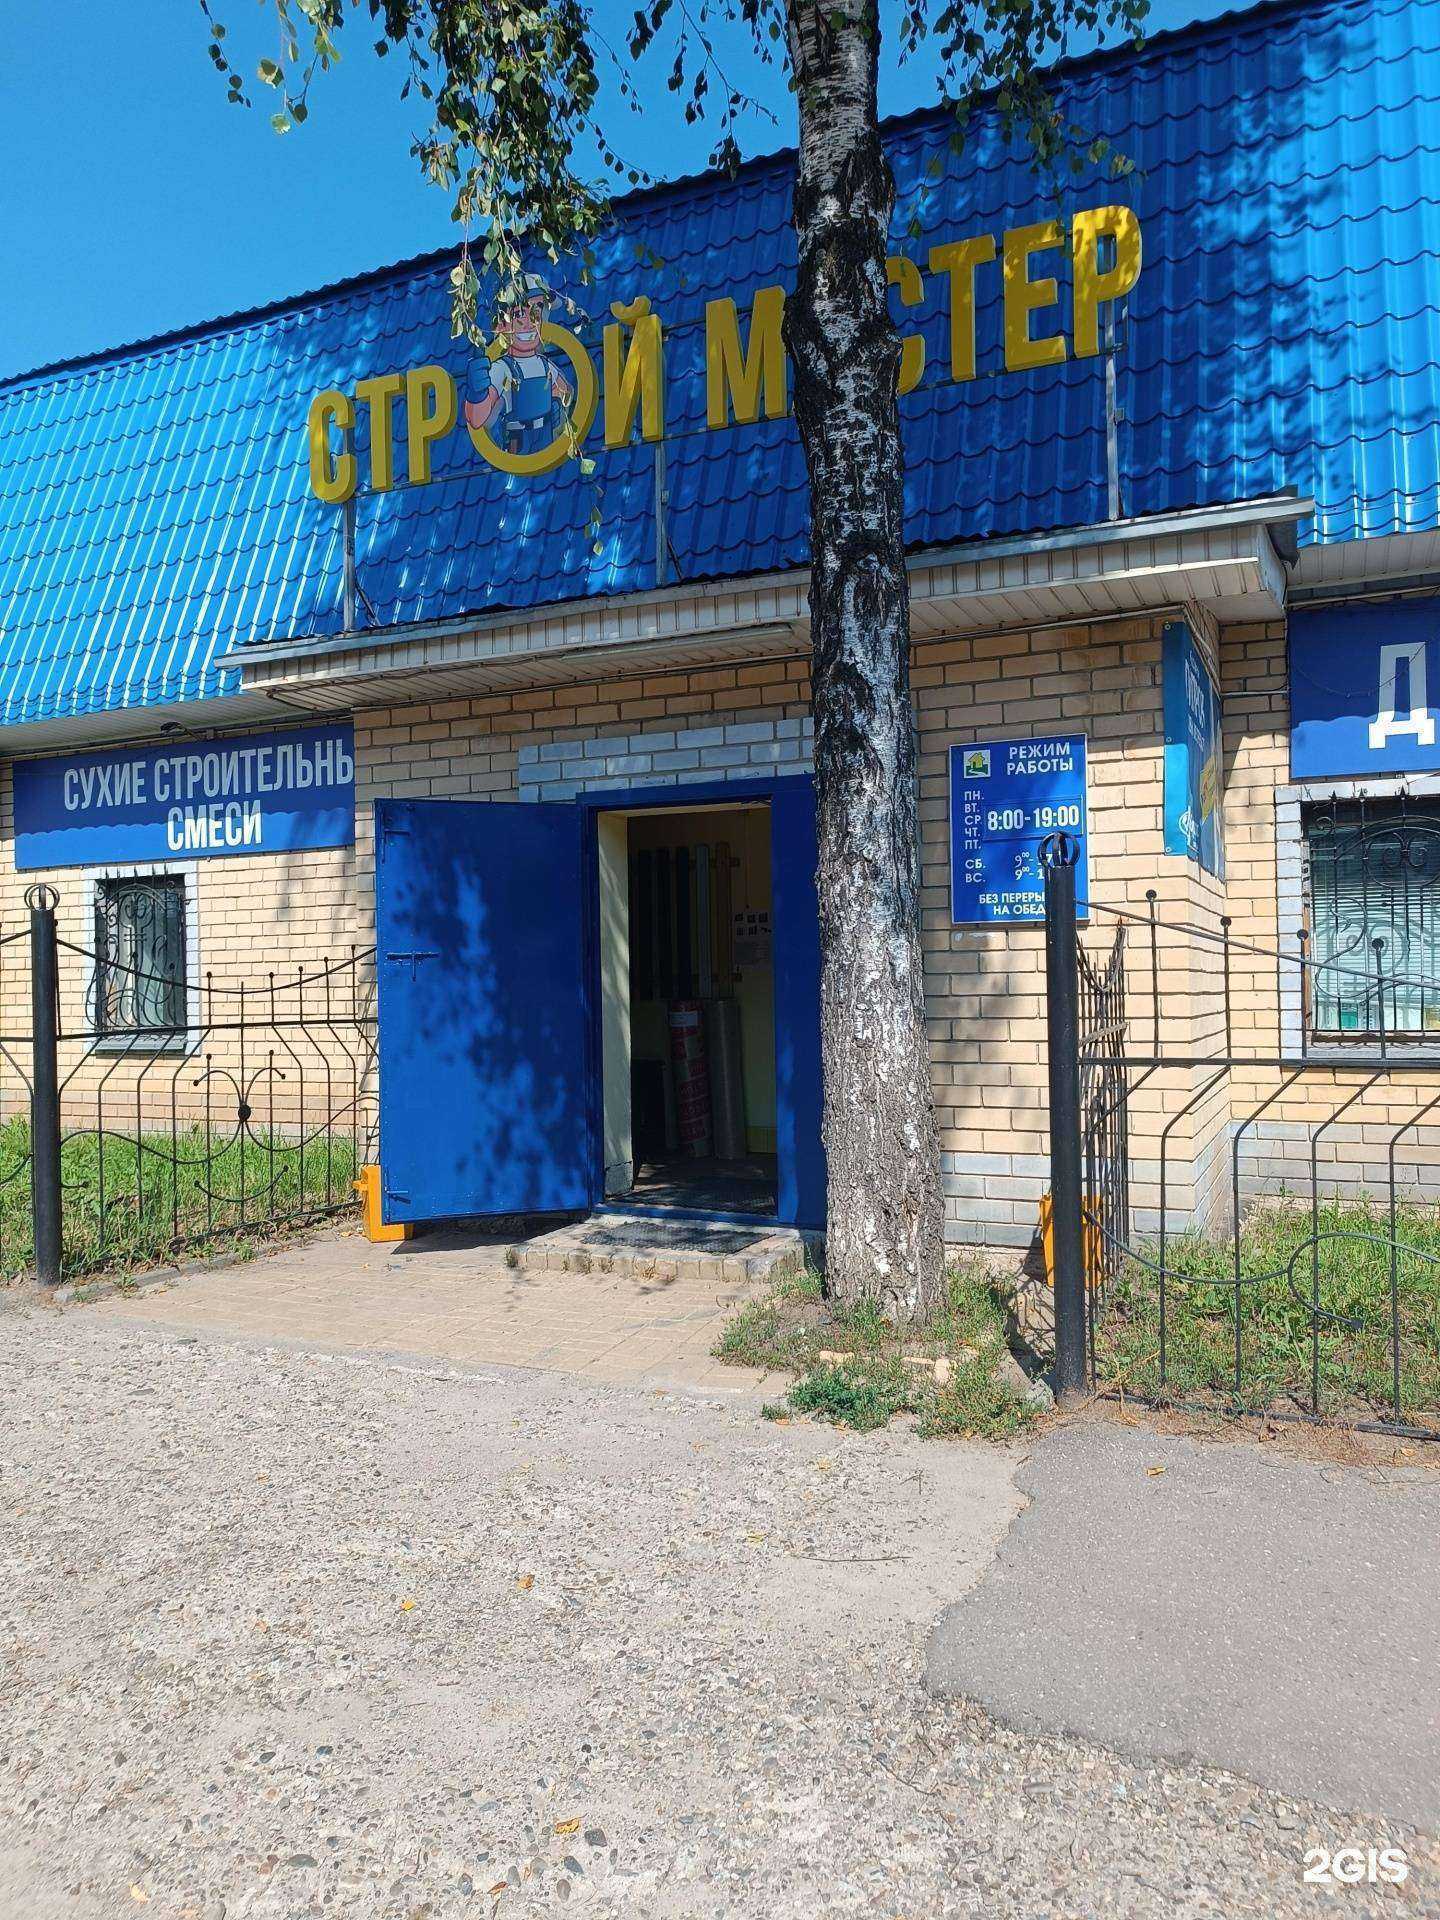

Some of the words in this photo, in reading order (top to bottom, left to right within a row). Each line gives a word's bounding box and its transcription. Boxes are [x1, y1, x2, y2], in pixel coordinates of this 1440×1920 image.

[705, 205, 1142, 430] МСТЕР
[1009, 742, 1071, 760] РЕЖИМ
[1006, 757, 1073, 775] РАБОТЫ
[63, 761, 147, 811] СУХИЕ
[964, 791, 985, 801] ПН.
[964, 803, 980, 813] ВТ.
[167, 800, 262, 851] СМЕСИ
[965, 858, 986, 869] СБ.
[965, 872, 986, 883] ВС.
[979, 893, 999, 904] БЕЗ
[993, 905, 1010, 915] НА
[1013, 904, 1046, 915] ОБЕД
